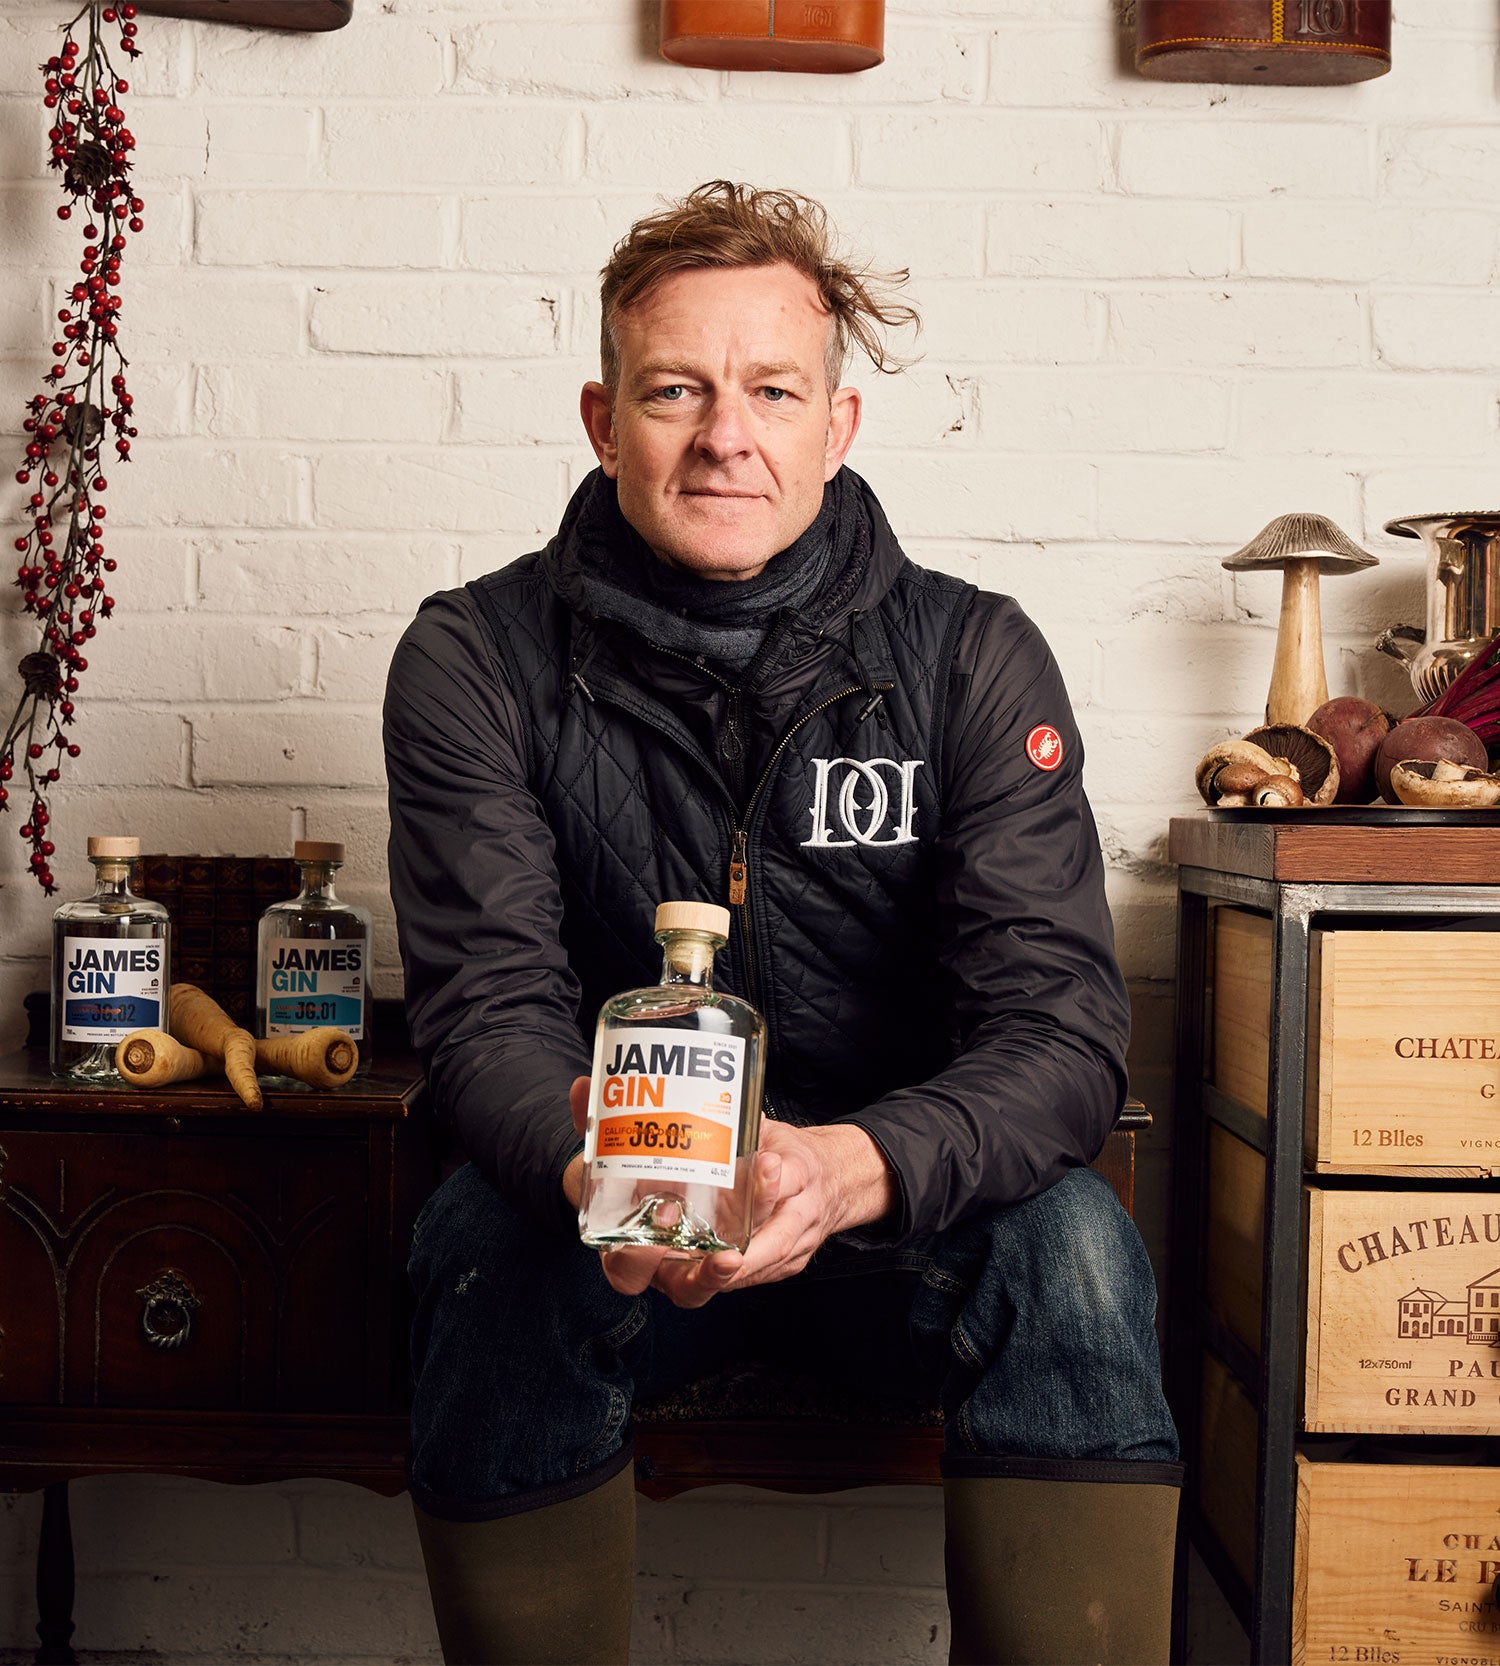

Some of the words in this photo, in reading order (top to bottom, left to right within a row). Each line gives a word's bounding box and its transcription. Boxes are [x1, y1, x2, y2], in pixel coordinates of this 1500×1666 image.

[68, 948, 160, 972] JAMES
[272, 948, 362, 971] JAMES
[67, 971, 116, 994] GIN
[271, 970, 318, 993] GIN
[295, 1002, 337, 1020] JG.01
[1395, 1037, 1500, 1060] CHATE
[606, 1043, 736, 1082] JAMES
[603, 1076, 665, 1108] GIN
[629, 1121, 692, 1150] JG.05
[1352, 1129, 1372, 1147] 12
[1337, 1213, 1500, 1273] CHATEAU
[1358, 1359, 1412, 1370] 12x750ml
[1385, 1388, 1476, 1407] GRAND
[1404, 1558, 1458, 1583] LE
[1459, 1621, 1486, 1633] CRU
[1328, 1645, 1349, 1663] 12
[1436, 1656, 1500, 1666] VIGNOBL
